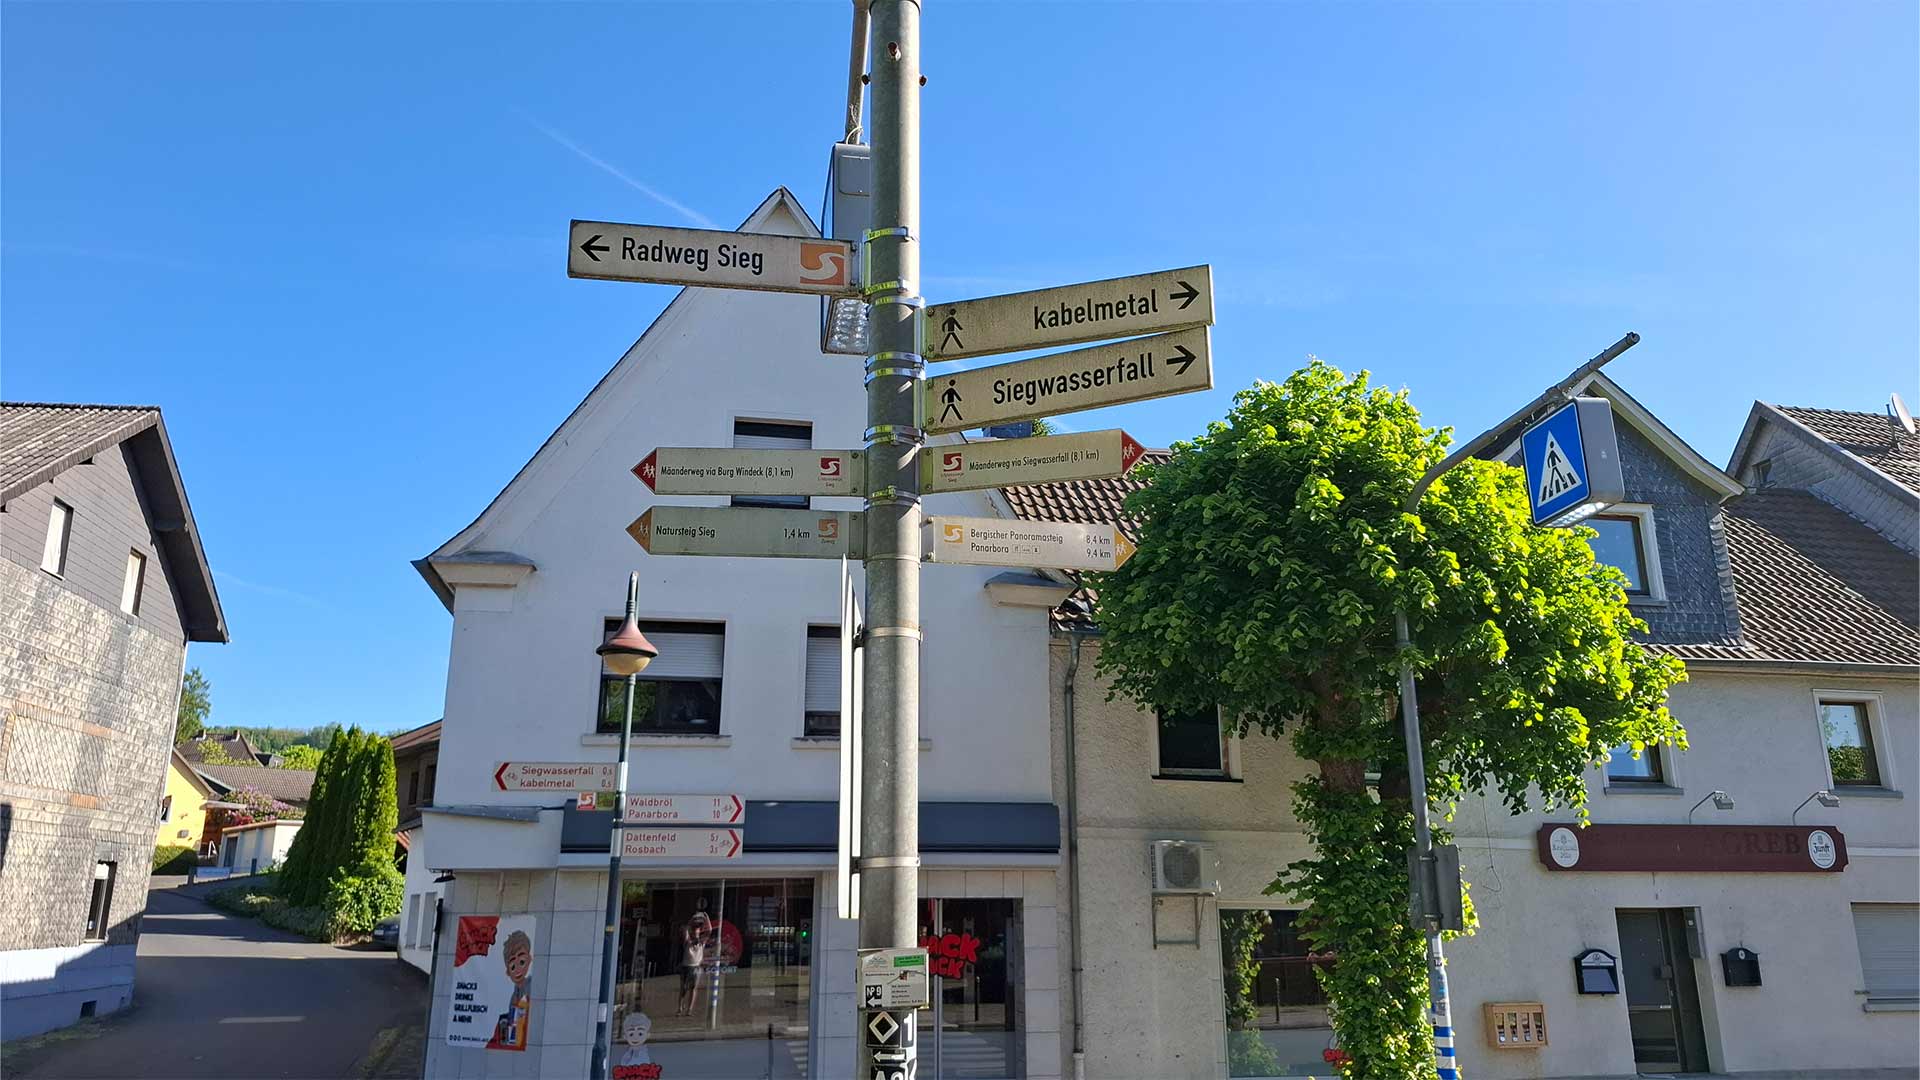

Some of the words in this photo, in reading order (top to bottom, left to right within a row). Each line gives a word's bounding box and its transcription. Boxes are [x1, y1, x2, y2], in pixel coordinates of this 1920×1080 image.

[621, 236, 709, 271] Radweg
[717, 244, 764, 276] Sieg
[1033, 288, 1159, 330] kabelmetal
[992, 351, 1155, 405] Siegwasserfall
[969, 459, 1010, 471] Mäanderweg
[1011, 456, 1022, 467] via
[1023, 453, 1069, 467] Siegwasserfall
[1071, 451, 1083, 464] (8,1
[1085, 449, 1100, 461] km)
[660, 466, 705, 478] Mäanderweg
[706, 466, 716, 476] via
[717, 467, 734, 478] Burg
[736, 467, 764, 477] Windeck
[765, 467, 778, 478] (8,1
[780, 467, 794, 478] km)
[656, 525, 697, 538] Natursteig
[698, 526, 716, 539] Sieg
[784, 528, 796, 539] 1,4
[797, 528, 810, 539] km
[970, 528, 1008, 540] Bergischer
[1010, 532, 1063, 544] Panoramasteig
[1086, 534, 1097, 546] 8,4
[1099, 535, 1111, 545] km
[971, 542, 1009, 554] Panarbora
[1100, 548, 1111, 558] km
[521, 766, 594, 777] Siegwasserfall
[519, 778, 575, 788] kabelmetal
[630, 796, 673, 807] Waldbröl
[712, 798, 721, 807] 11
[628, 809, 679, 819] Panarbora
[712, 810, 721, 819] 10
[625, 832, 676, 842] Dattenfeld
[625, 845, 666, 854] Rosbach
[876, 986, 882, 997] 9
